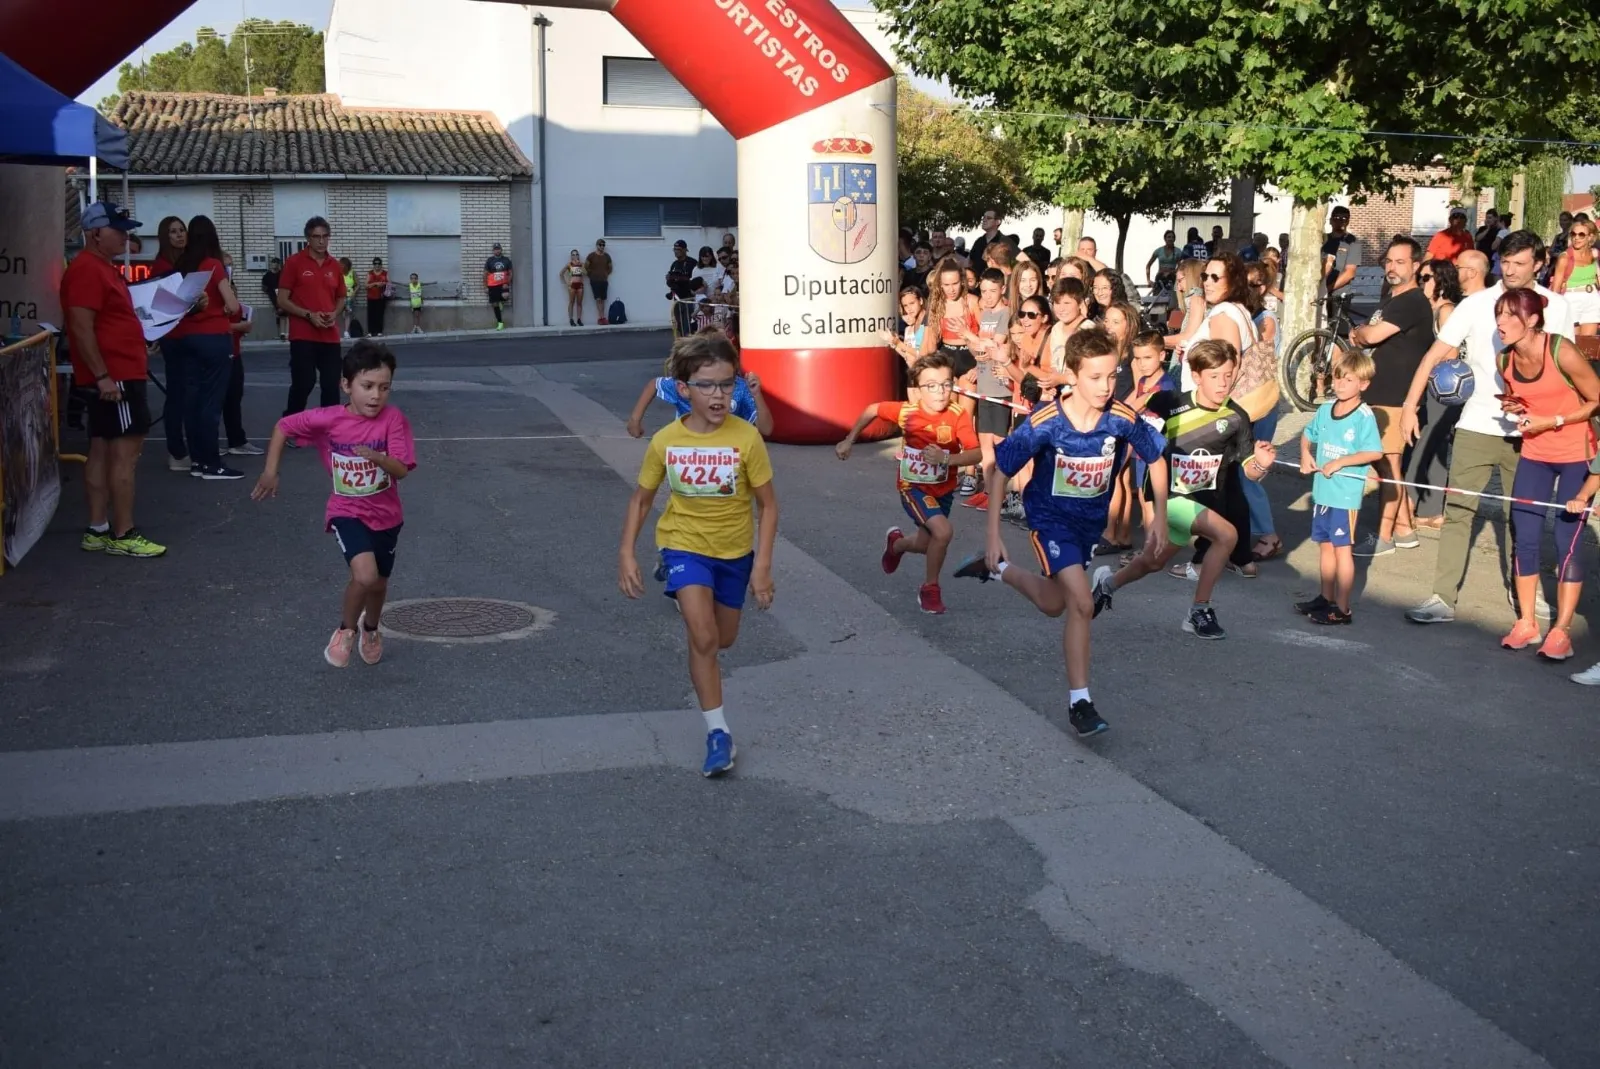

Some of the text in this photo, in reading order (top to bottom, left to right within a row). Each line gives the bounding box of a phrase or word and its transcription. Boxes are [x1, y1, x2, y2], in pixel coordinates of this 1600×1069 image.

[784, 272, 892, 300] Diputación
[773, 312, 896, 335] de Salamanca
[333, 457, 378, 471] bedun
[909, 462, 937, 475] 421
[342, 469, 377, 487] 427
[680, 467, 721, 485] 424
[1066, 471, 1103, 488] 420
[1181, 470, 1209, 484] 423
